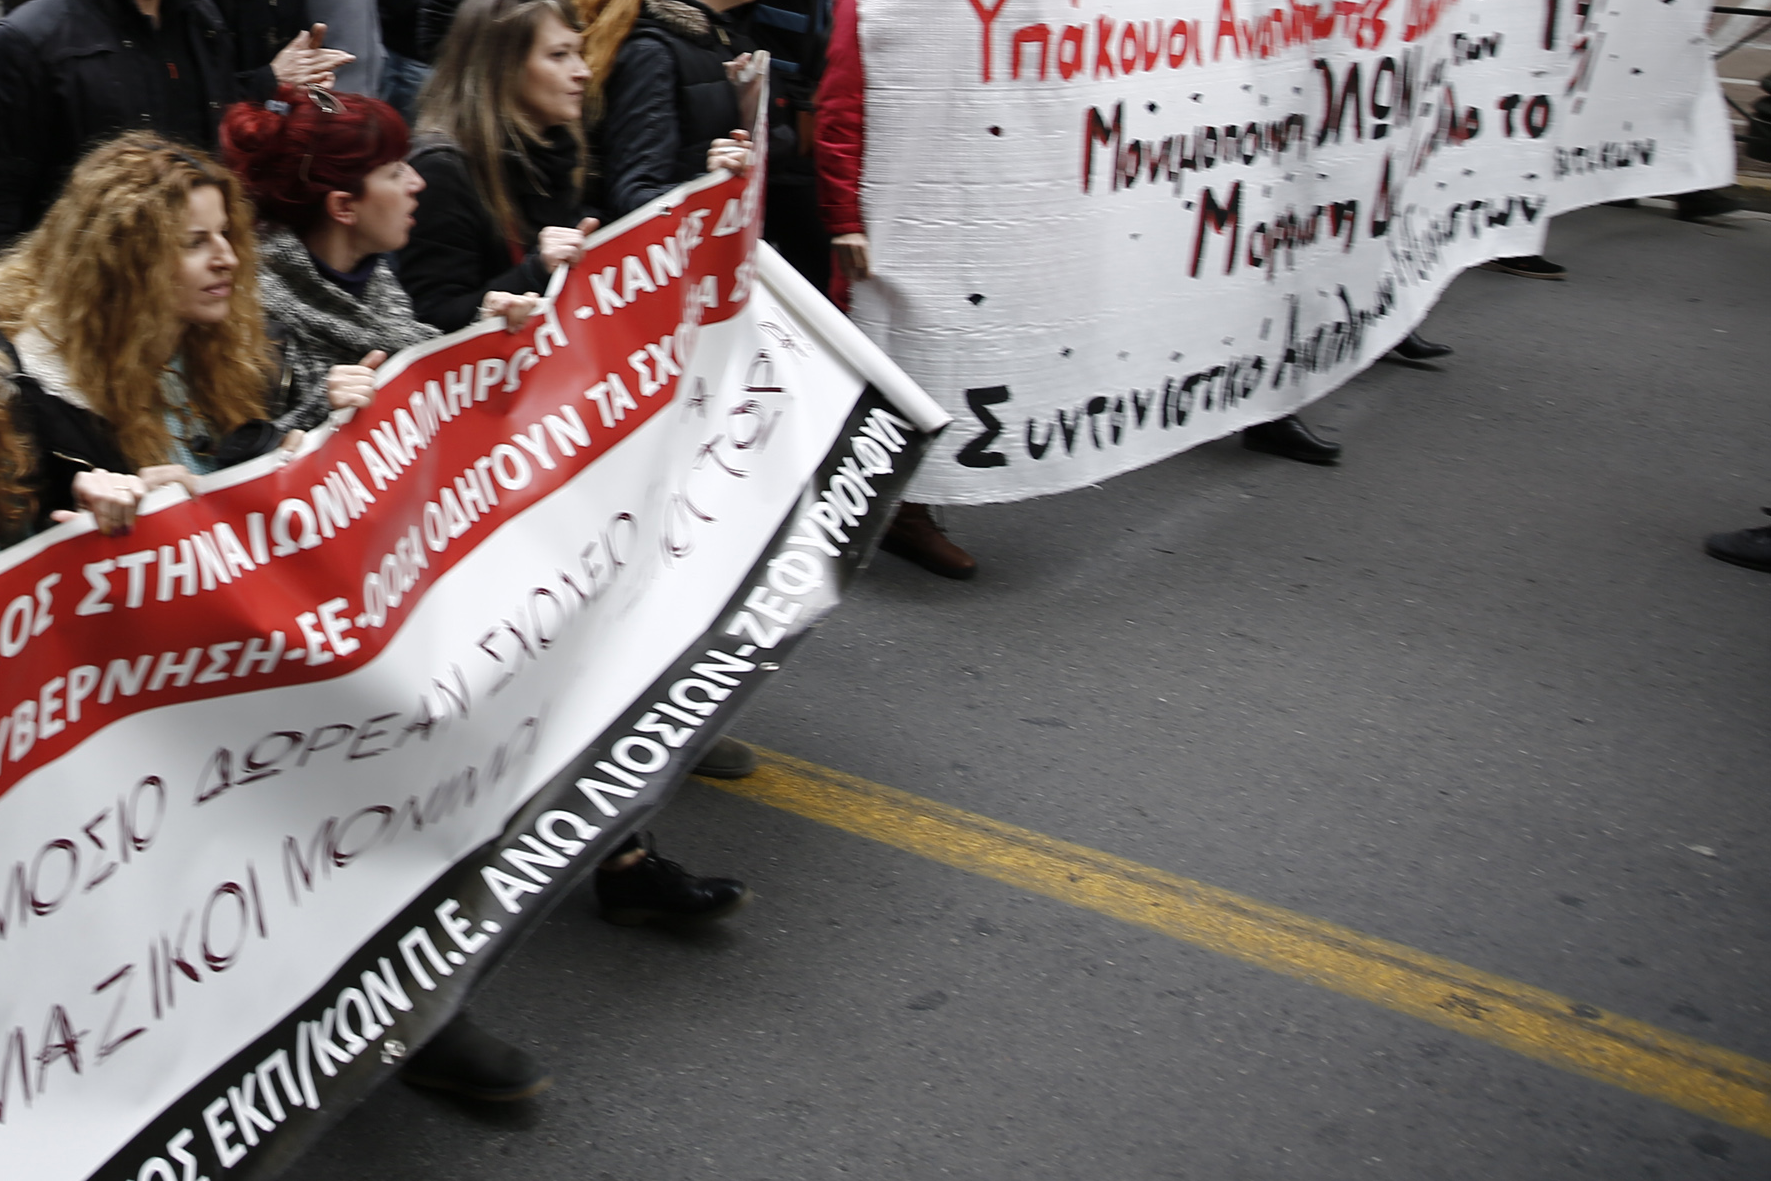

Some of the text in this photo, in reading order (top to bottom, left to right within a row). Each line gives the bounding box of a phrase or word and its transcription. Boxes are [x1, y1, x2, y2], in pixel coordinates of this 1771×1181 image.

[423, 404, 592, 553] ΟΔΗΓΟΥΝ
[583, 372, 639, 429] ΤΑ
[202, 956, 414, 1169] ΕΚΠ/ΚΩΝ
[398, 899, 502, 991] Π.Ε.
[480, 808, 603, 914] ΑΝΩ
